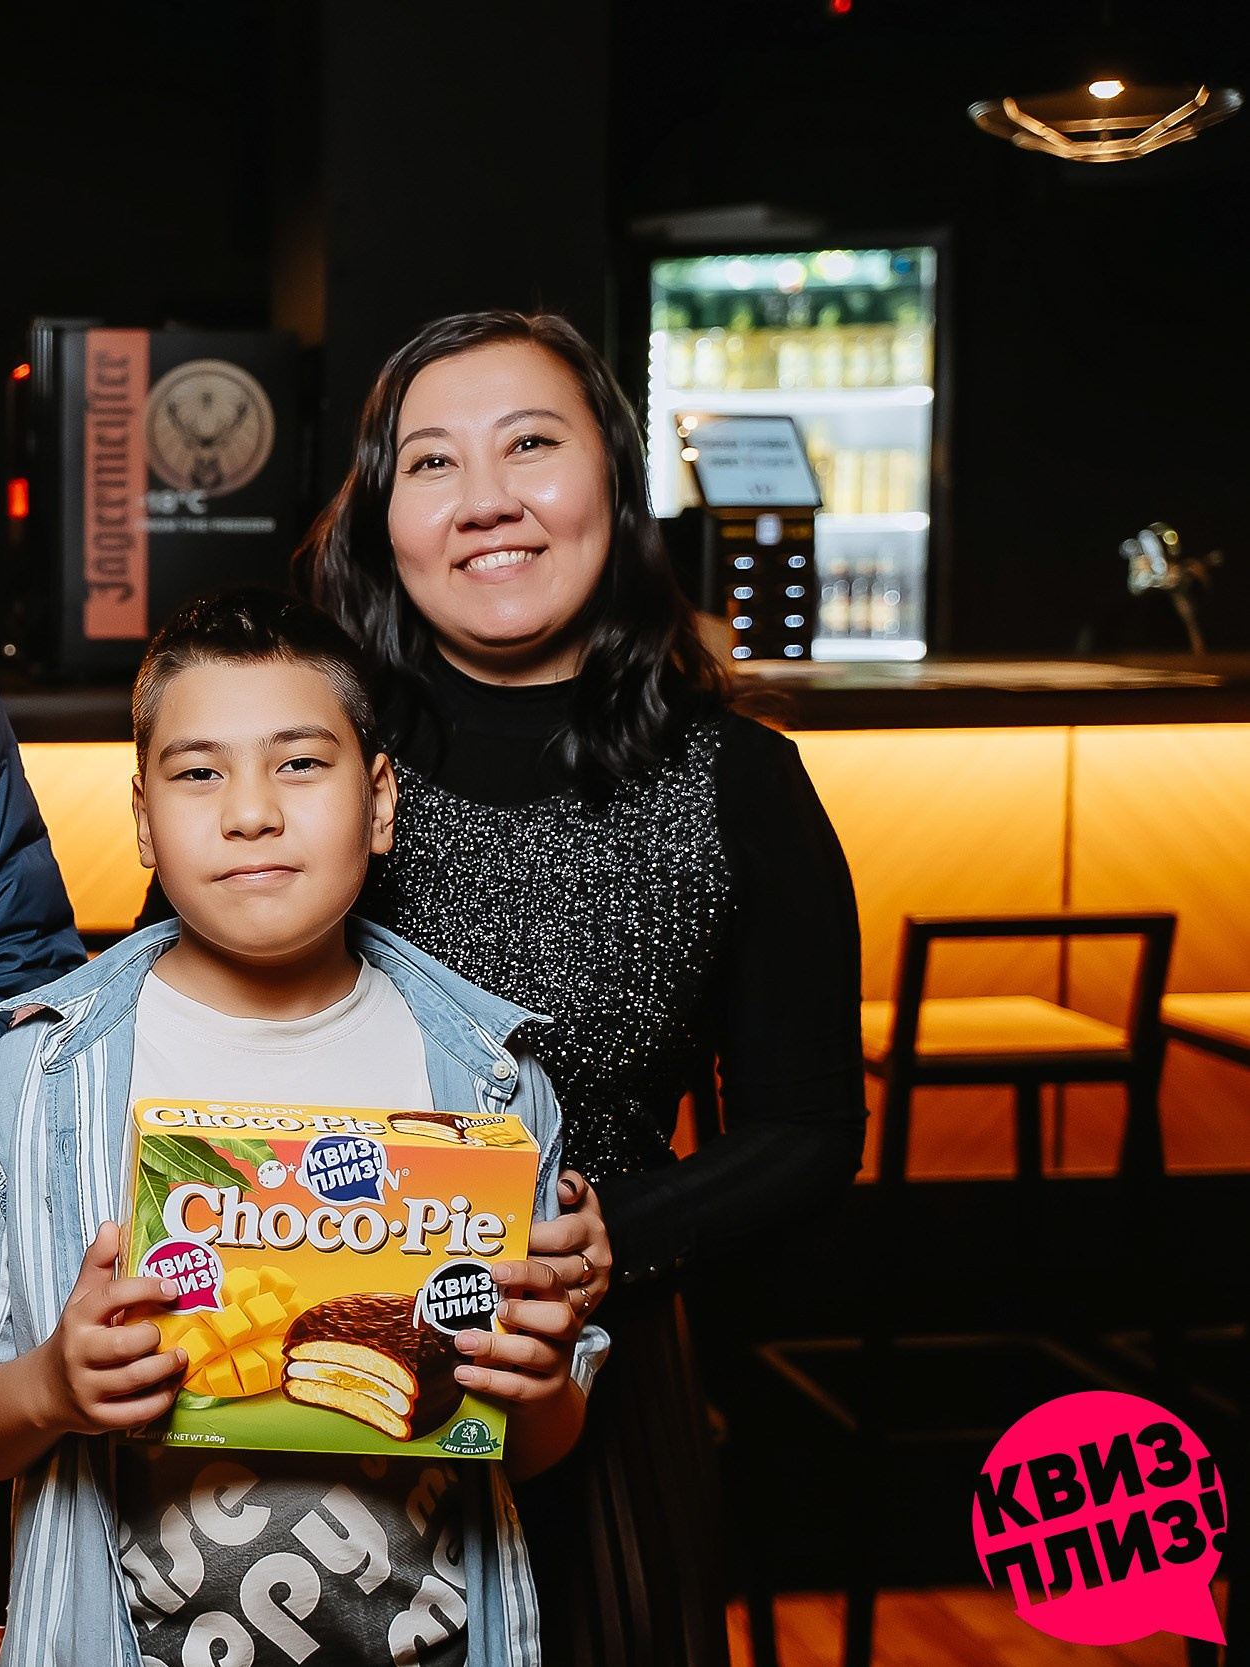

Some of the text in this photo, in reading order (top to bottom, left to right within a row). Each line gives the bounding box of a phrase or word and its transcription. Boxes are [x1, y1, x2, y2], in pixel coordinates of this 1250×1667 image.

[232, 1105, 304, 1116] ORION
[309, 1140, 379, 1173] КВИЗ,
[310, 1157, 383, 1193] ПЛИЗ!
[429, 1292, 499, 1320] ПЛИЗ!
[173, 1432, 190, 1441] NET
[190, 1433, 204, 1442] WT
[445, 1443, 462, 1453] BEEF
[462, 1445, 491, 1454] GELATIN
[143, 1482, 392, 1667] ppy
